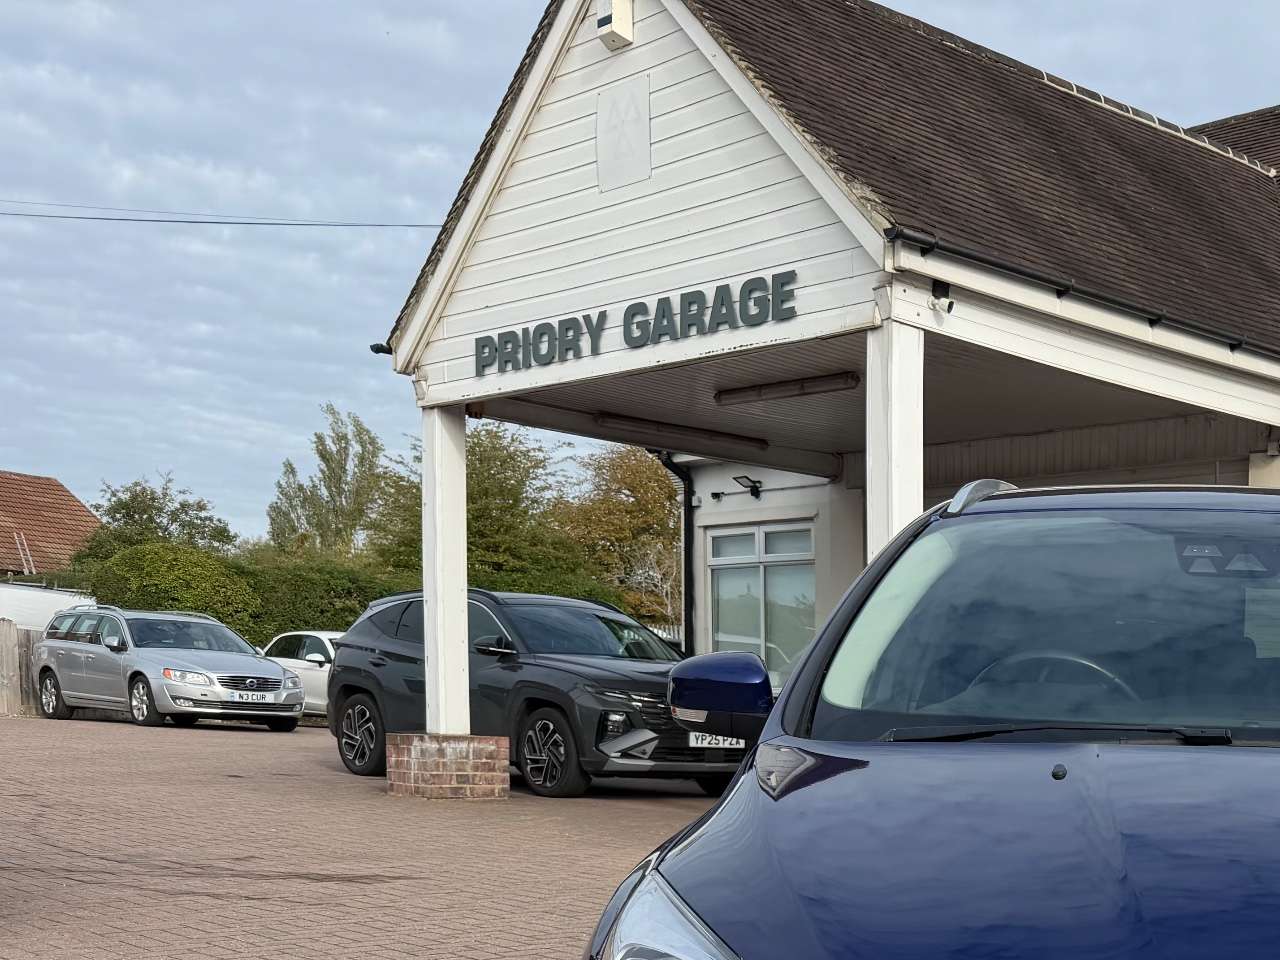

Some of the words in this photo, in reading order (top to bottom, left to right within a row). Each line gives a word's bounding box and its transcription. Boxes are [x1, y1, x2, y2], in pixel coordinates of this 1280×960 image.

[474, 309, 607, 378] PRIORY
[623, 269, 798, 350] GARAGE
[238, 693, 250, 701] N3
[251, 693, 267, 701] CUR
[694, 733, 721, 746] YP25
